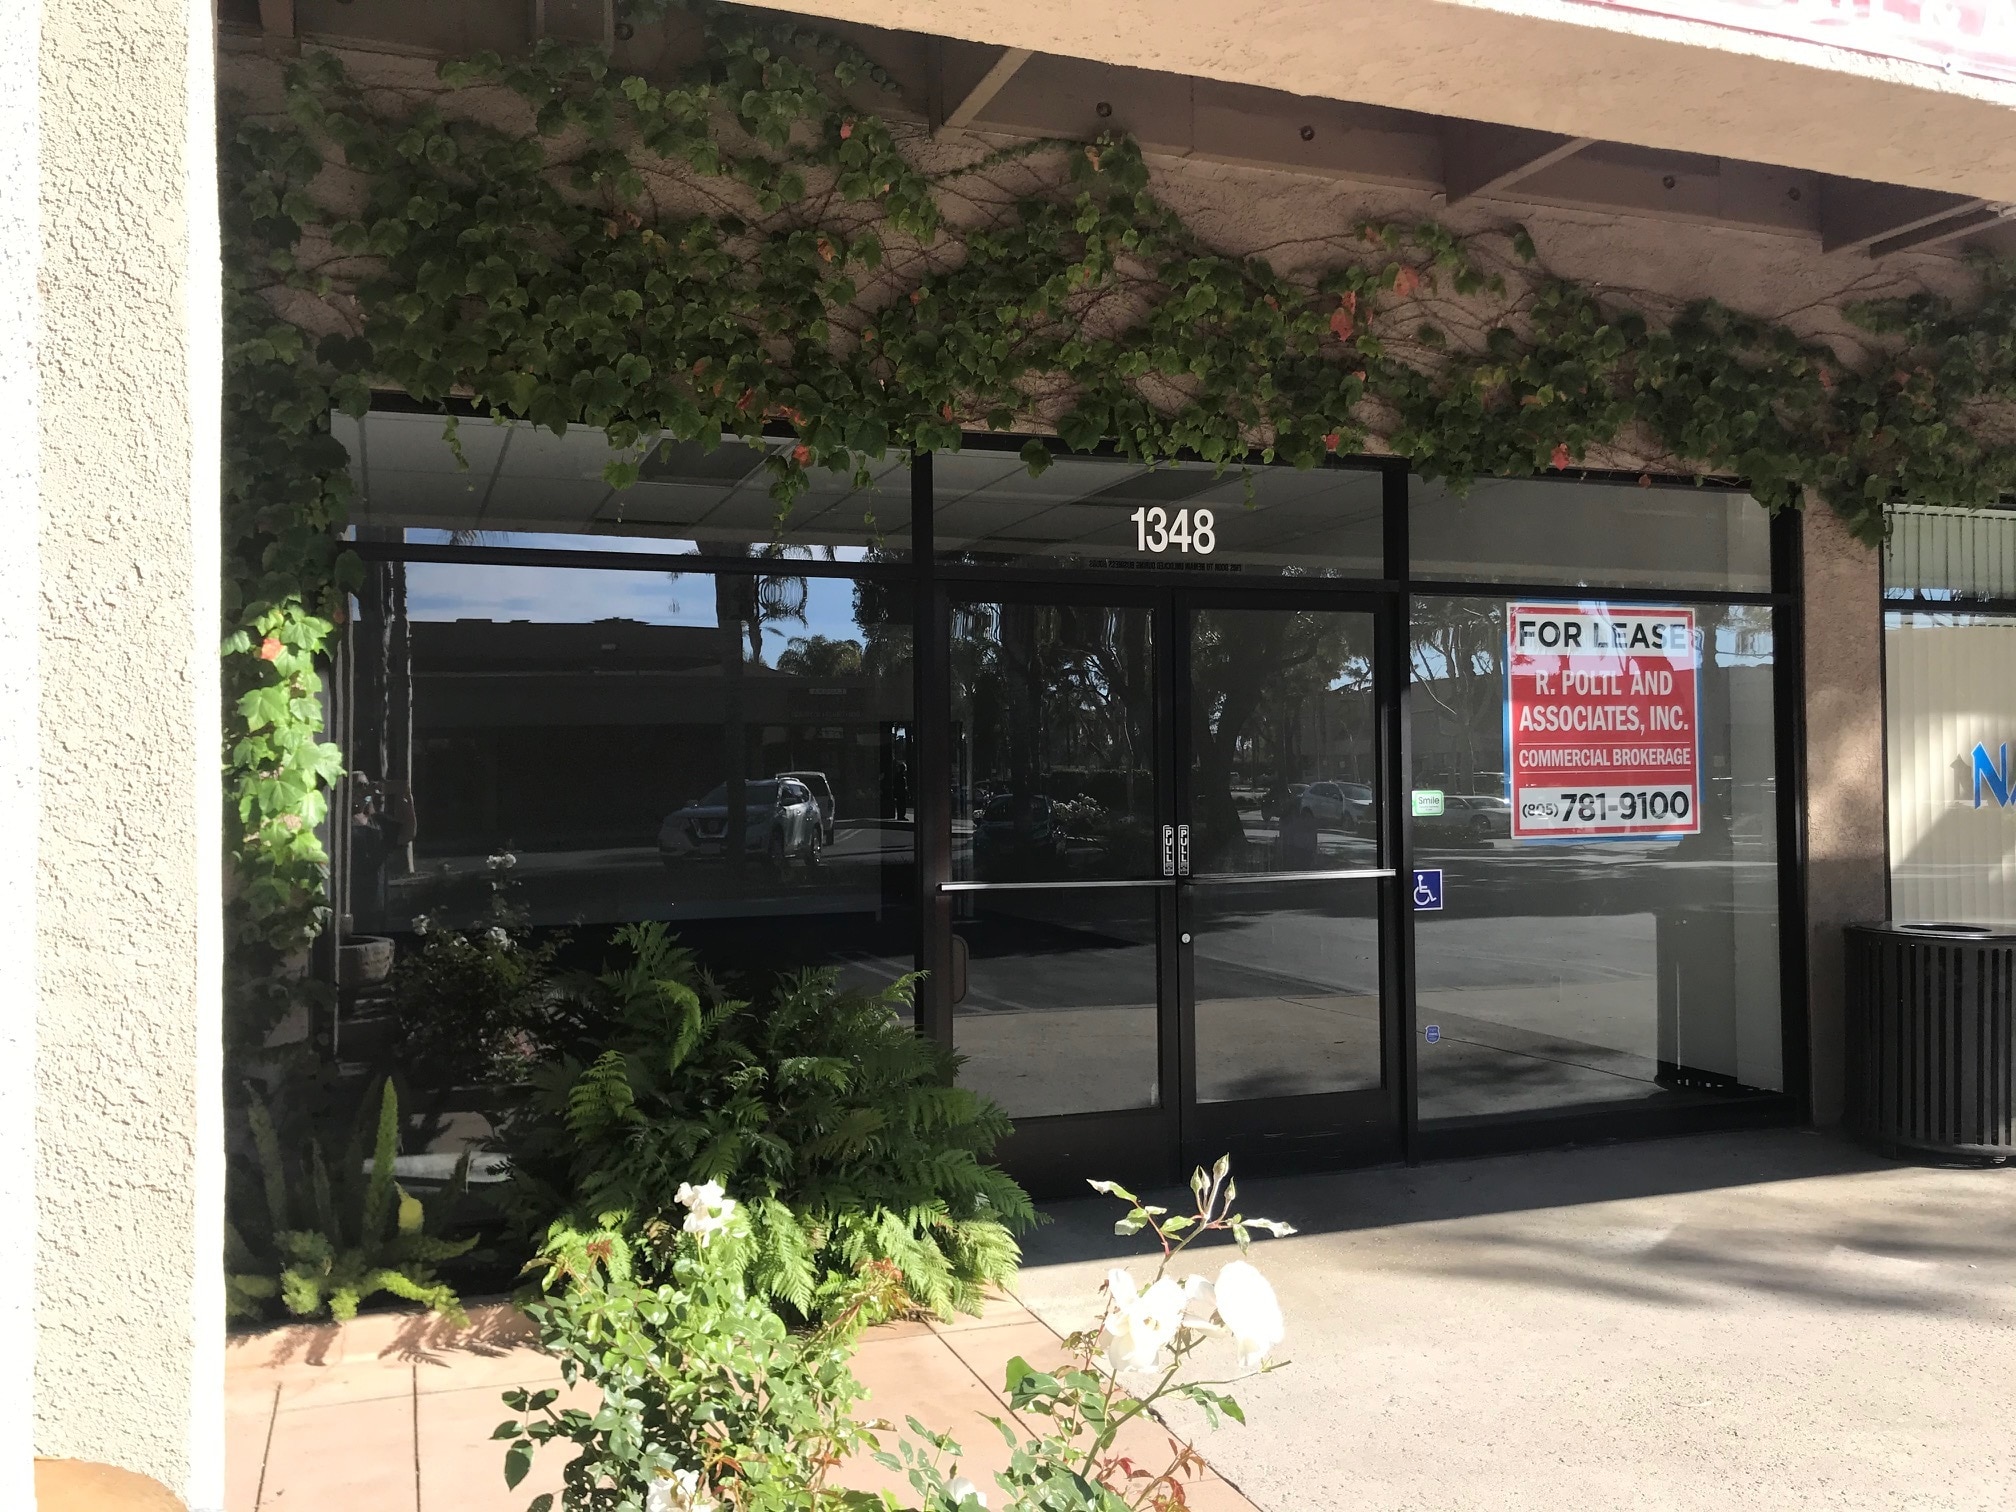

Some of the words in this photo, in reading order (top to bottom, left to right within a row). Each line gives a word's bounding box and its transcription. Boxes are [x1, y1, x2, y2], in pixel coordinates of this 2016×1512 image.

[1130, 506, 1216, 555] 1348
[1519, 621, 1582, 648] FOR
[1593, 622, 1686, 650] LEASE
[1535, 670, 1555, 695] R.
[1562, 670, 1621, 696] POLTL
[1630, 671, 1673, 696] AND
[1519, 706, 1645, 736] ASSOCIATES,
[1650, 705, 1689, 731] INC.
[1519, 749, 1610, 767] COMMERCIAL
[1613, 748, 1691, 766] BROKERAGE
[1970, 741, 2016, 809] N
[1418, 796, 1440, 805] Smile
[1522, 802, 1559, 818] (805)
[1560, 791, 1690, 822] 781-9100
